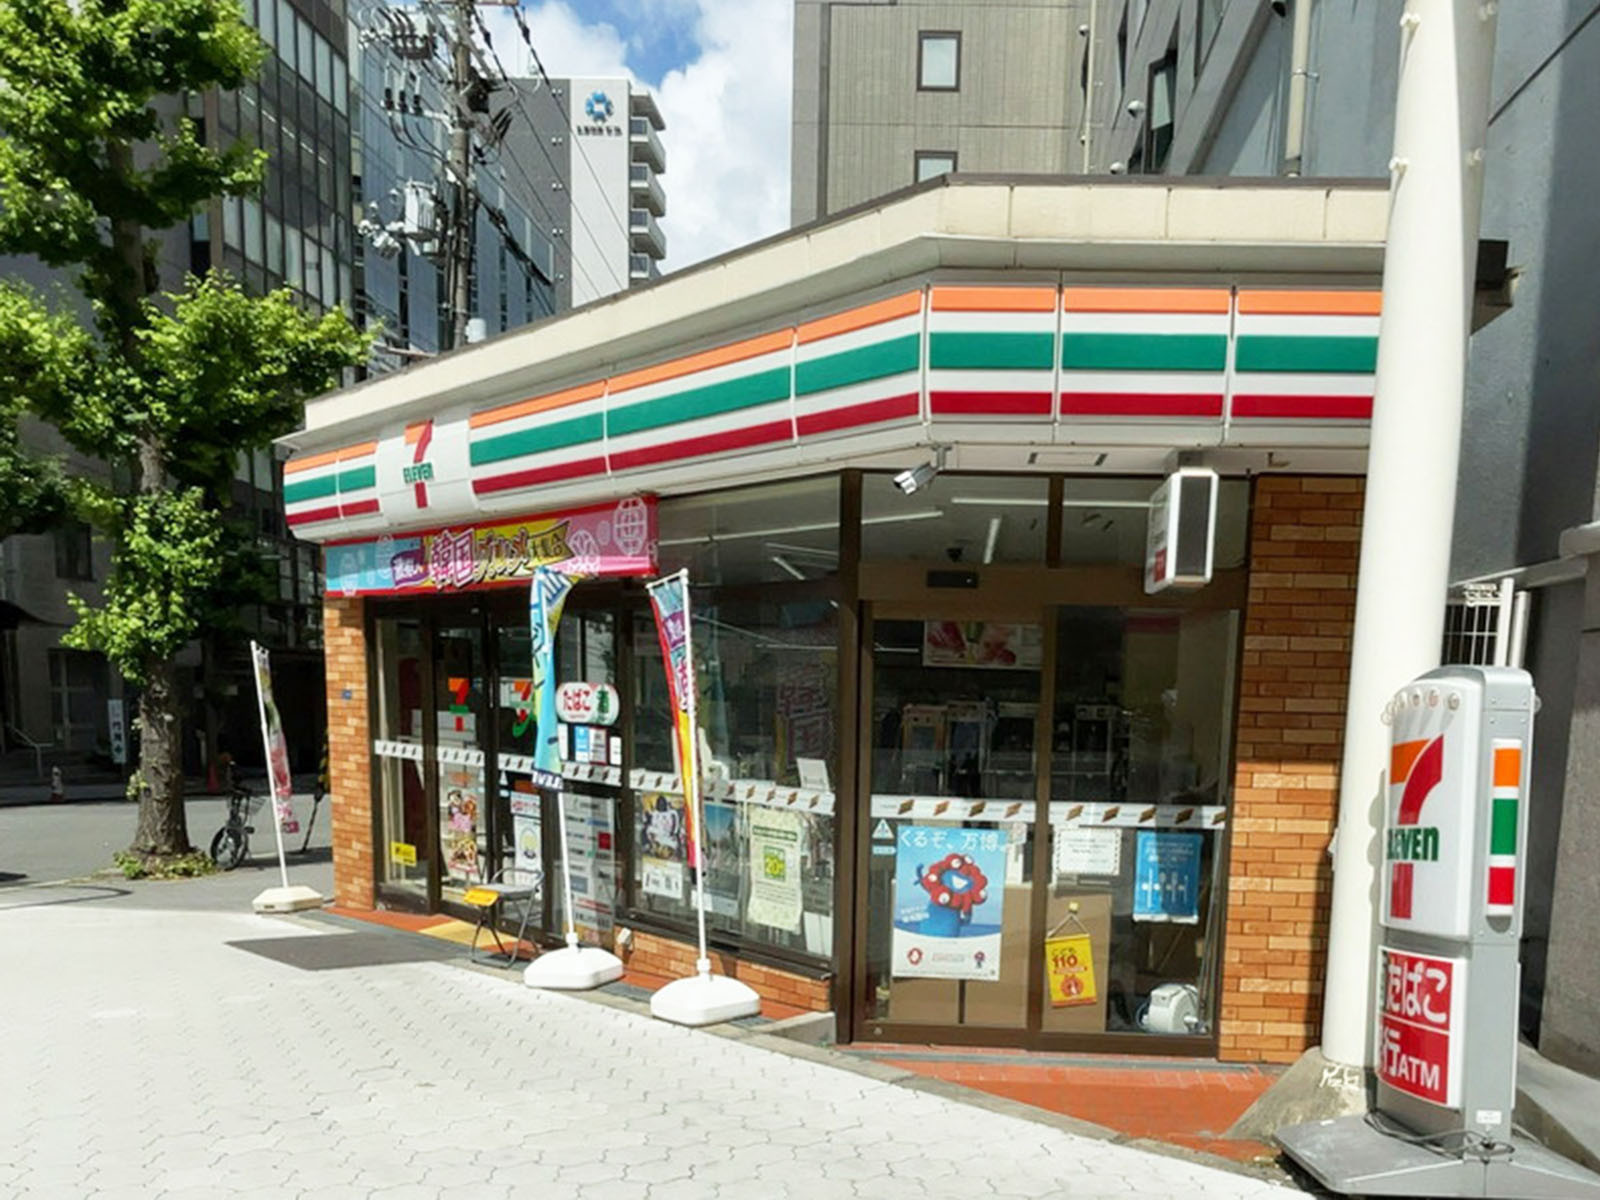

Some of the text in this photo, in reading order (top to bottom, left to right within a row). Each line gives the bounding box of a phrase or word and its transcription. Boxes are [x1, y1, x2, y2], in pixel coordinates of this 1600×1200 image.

[1389, 733, 1444, 920] 7
[1387, 958, 1448, 1023] たばこ
[1381, 1026, 1440, 1092] 行ATM
